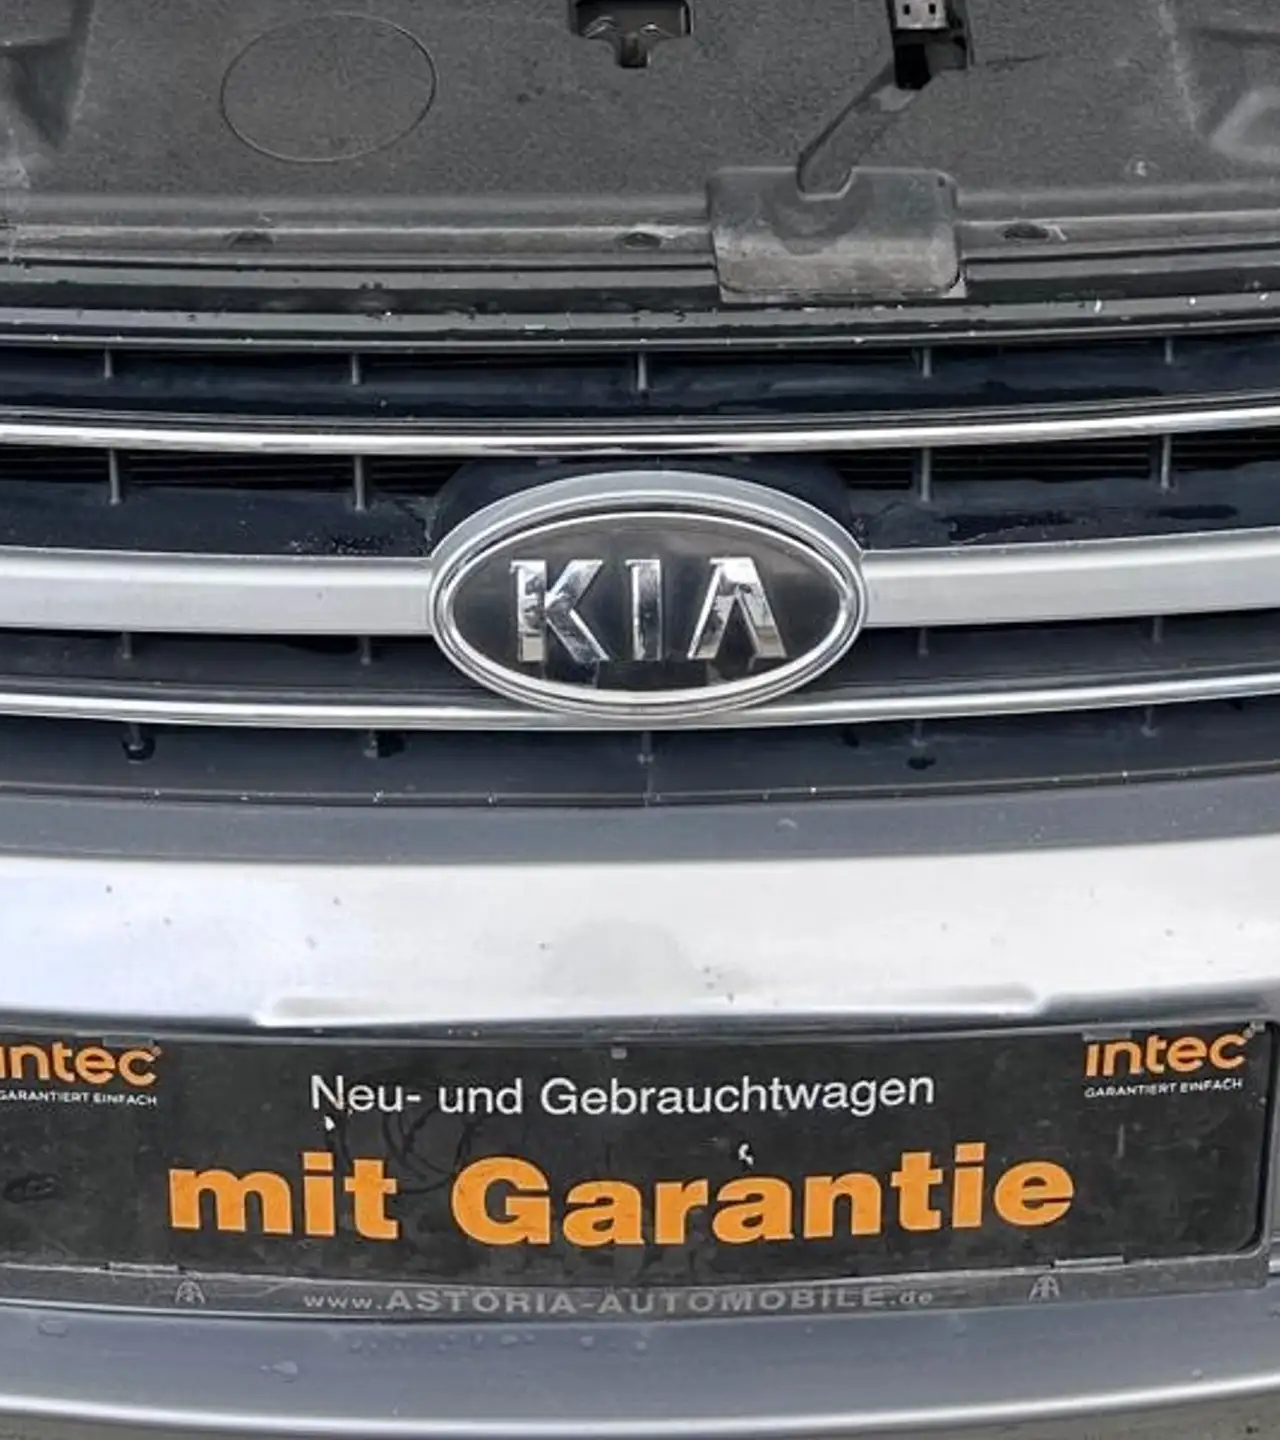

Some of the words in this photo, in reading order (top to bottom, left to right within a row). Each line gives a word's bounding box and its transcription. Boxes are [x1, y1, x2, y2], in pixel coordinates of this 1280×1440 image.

[509, 557, 788, 663] KIA
[1085, 1032, 1248, 1077] intec
[93, 1091, 157, 1106] EINFACH
[311, 1074, 421, 1112] Neu-
[439, 1078, 522, 1114] und
[540, 1075, 935, 1116] Gebrauchtwagen
[1084, 1082, 1176, 1099] GARANTIERT
[1179, 1077, 1243, 1094] EINFACH
[169, 1150, 400, 1242] mit
[450, 1142, 1076, 1246] Garantie
[303, 1285, 934, 1314] www.ASTORIA-AUTOMOBILE.de
